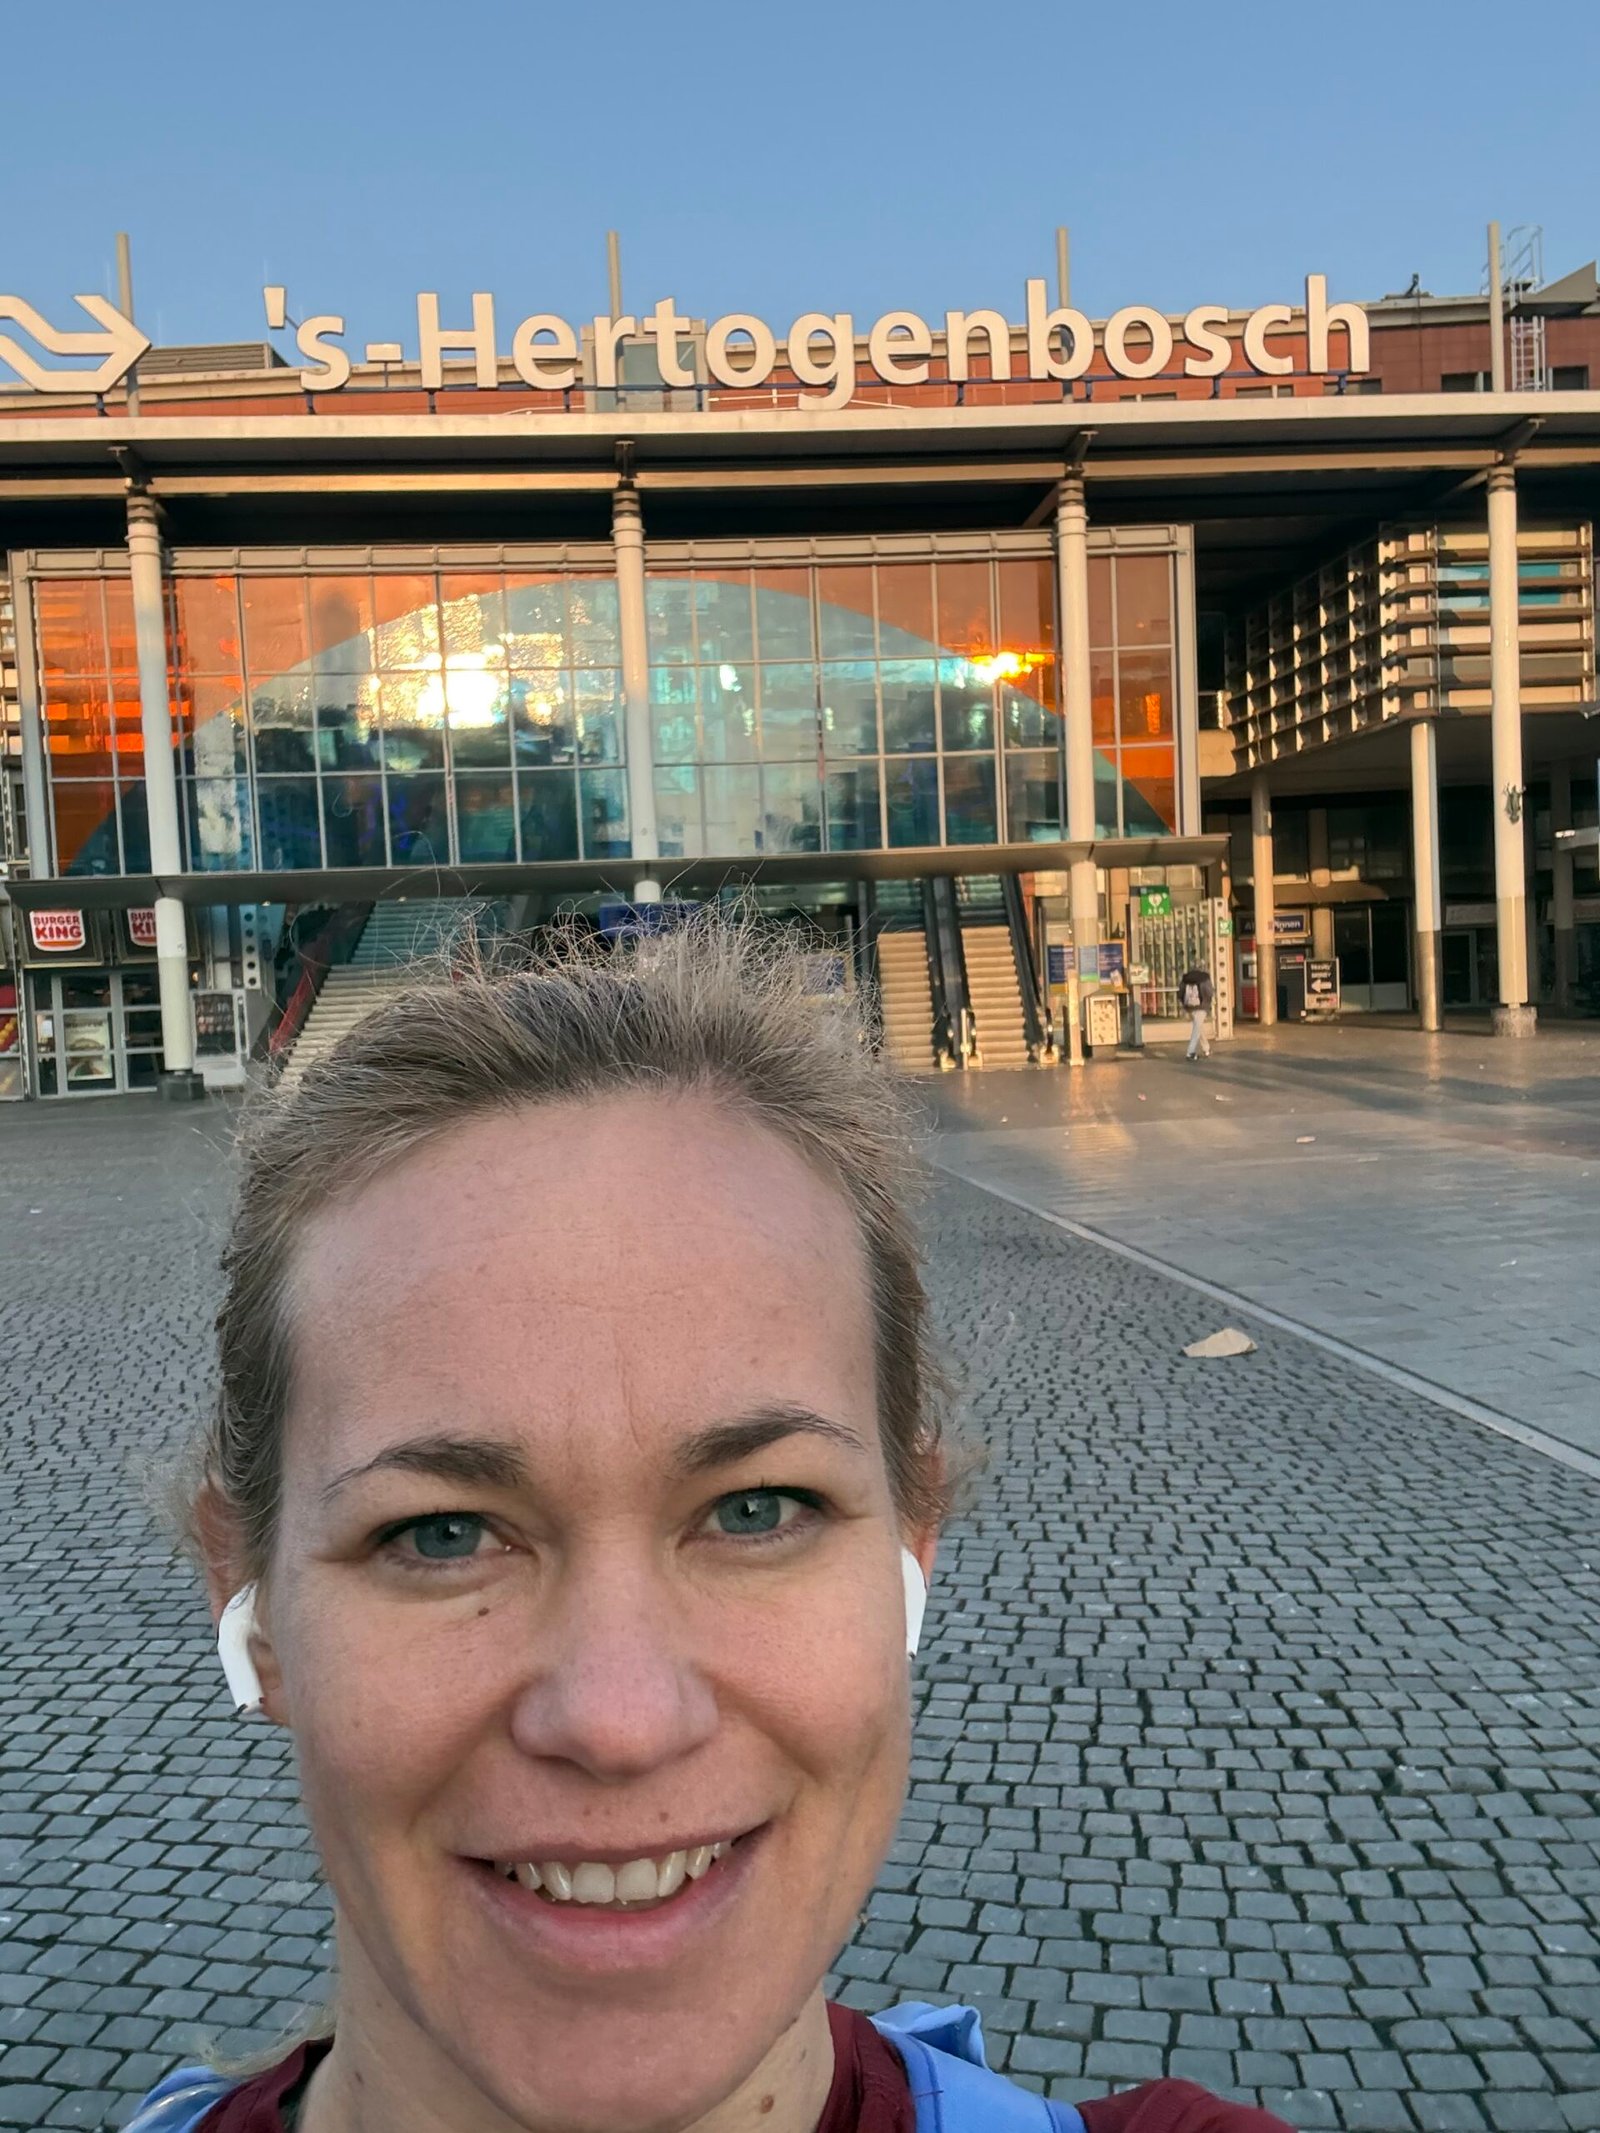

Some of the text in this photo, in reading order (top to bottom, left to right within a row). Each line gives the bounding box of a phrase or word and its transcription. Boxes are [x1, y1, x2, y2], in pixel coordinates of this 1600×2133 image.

[264, 274, 1370, 411] 's-Hertogenbosch
[33, 915, 80, 926] BURGER
[130, 911, 155, 922] BUR
[35, 925, 82, 939] KING
[132, 921, 156, 936] KI
